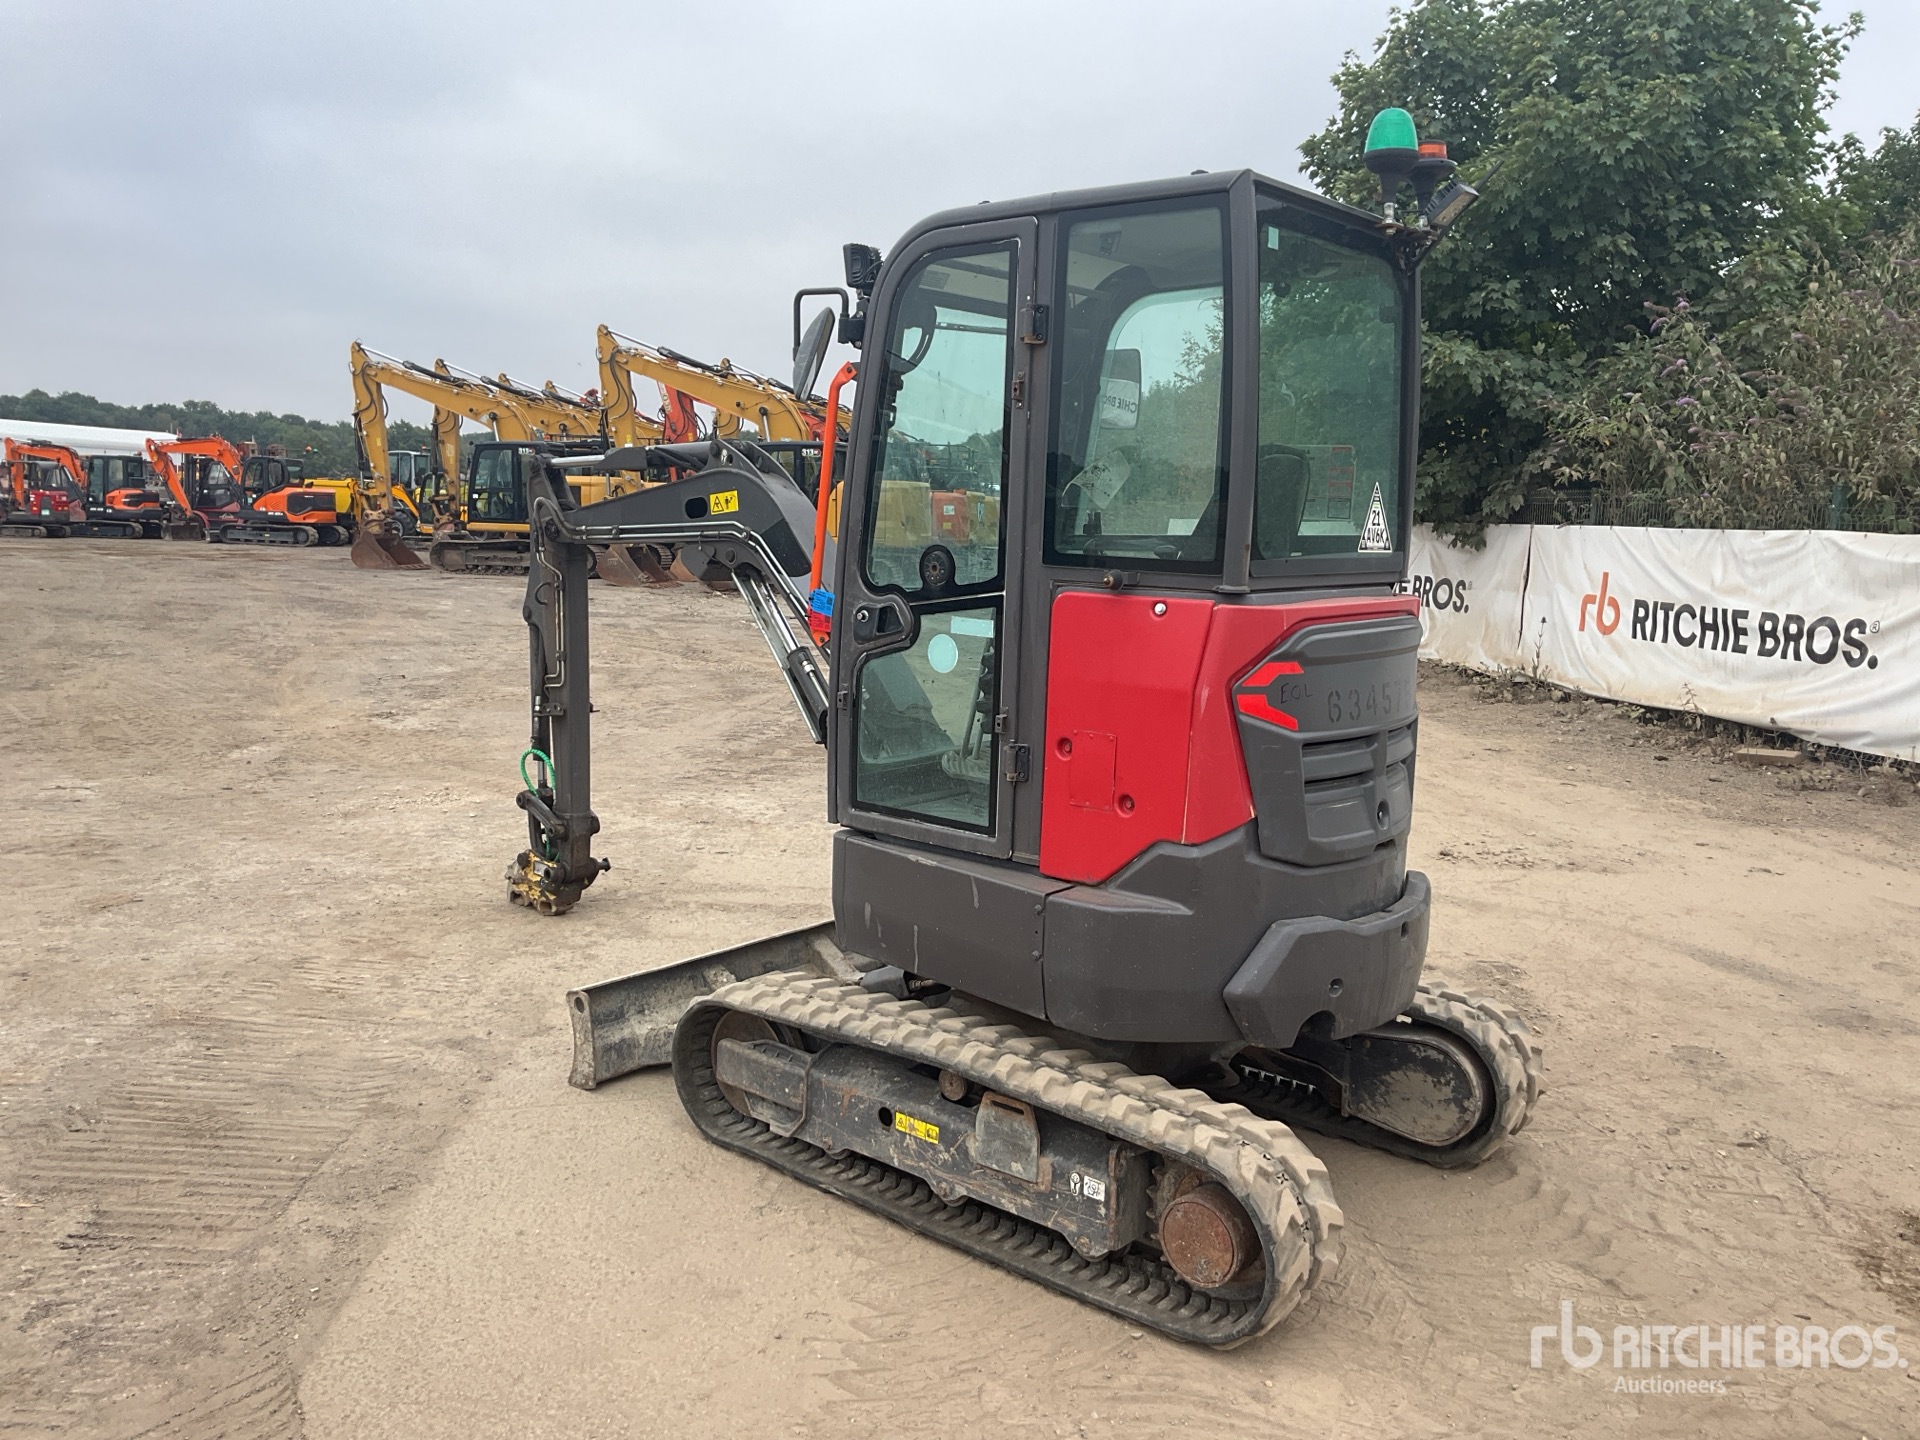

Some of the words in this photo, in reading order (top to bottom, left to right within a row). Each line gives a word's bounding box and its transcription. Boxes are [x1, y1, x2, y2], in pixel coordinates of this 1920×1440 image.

[801, 448, 814, 457] 313
[1372, 510, 1380, 527] 21
[1631, 598, 1749, 654] RITCHIE
